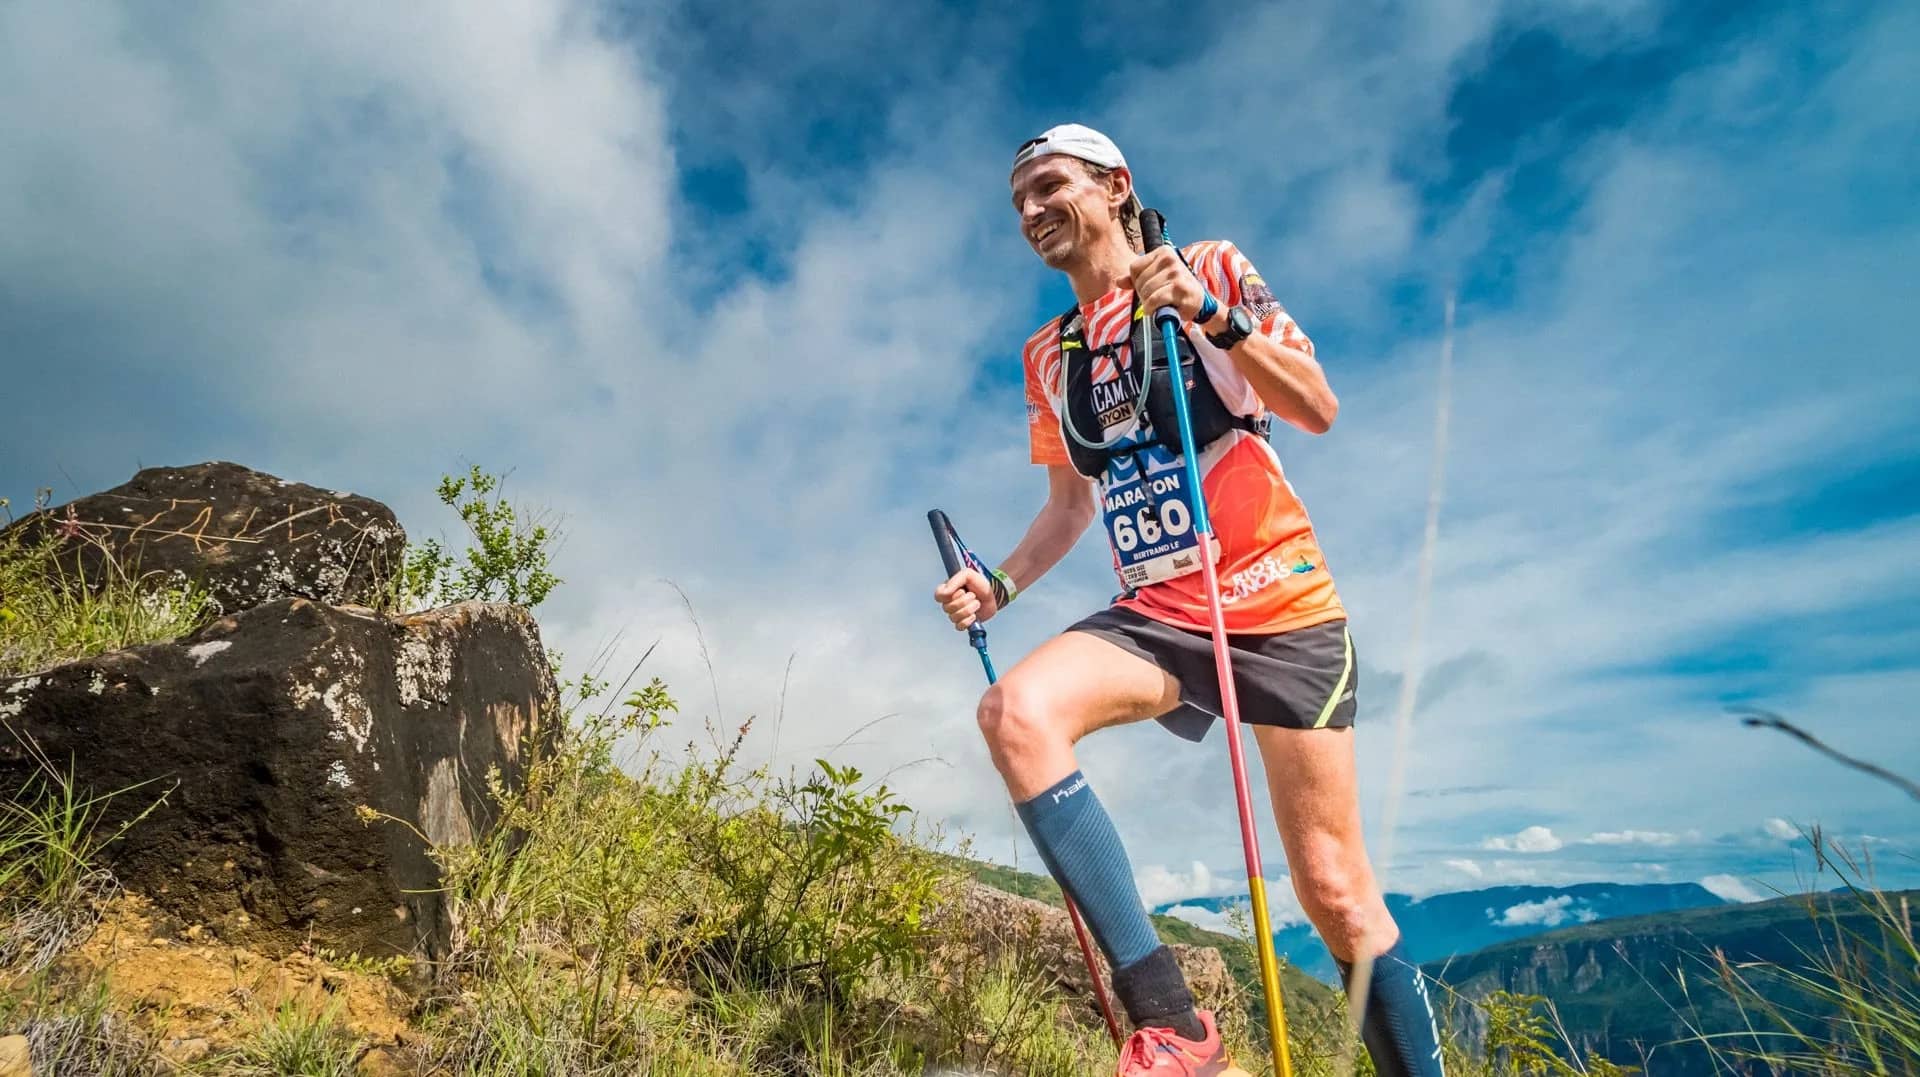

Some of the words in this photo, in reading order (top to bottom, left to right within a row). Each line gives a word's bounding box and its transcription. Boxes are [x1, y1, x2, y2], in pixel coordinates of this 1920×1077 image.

[1105, 474, 1180, 513] MARAON
[1113, 499, 1191, 552] 660
[1133, 544, 1170, 561] BERTRAND
[1170, 541, 1180, 550] LE
[1232, 556, 1275, 584] RIOS
